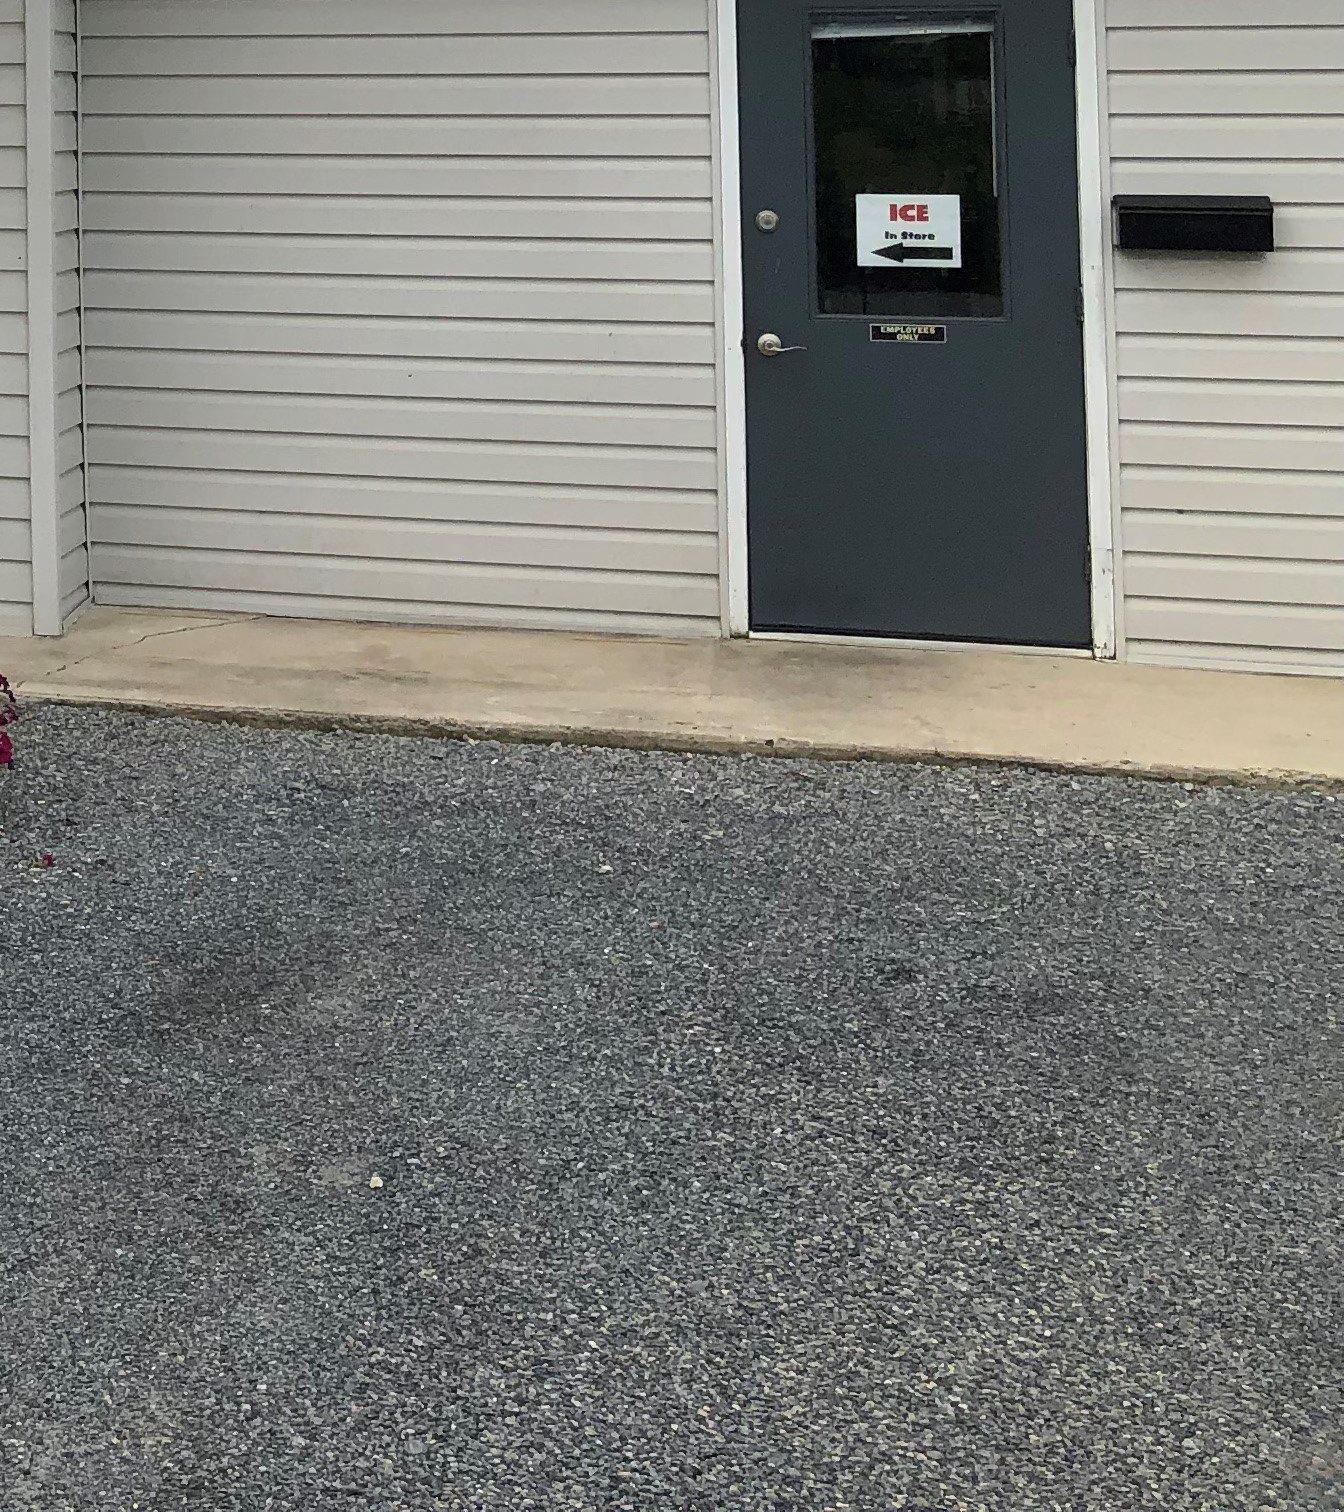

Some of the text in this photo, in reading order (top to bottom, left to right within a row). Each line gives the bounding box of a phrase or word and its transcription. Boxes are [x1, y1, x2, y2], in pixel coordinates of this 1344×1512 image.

[889, 203, 930, 222] ICE
[884, 230, 936, 241] In Store
[880, 326, 936, 335] EMPLOYEES
[896, 333, 920, 341] ONLY
